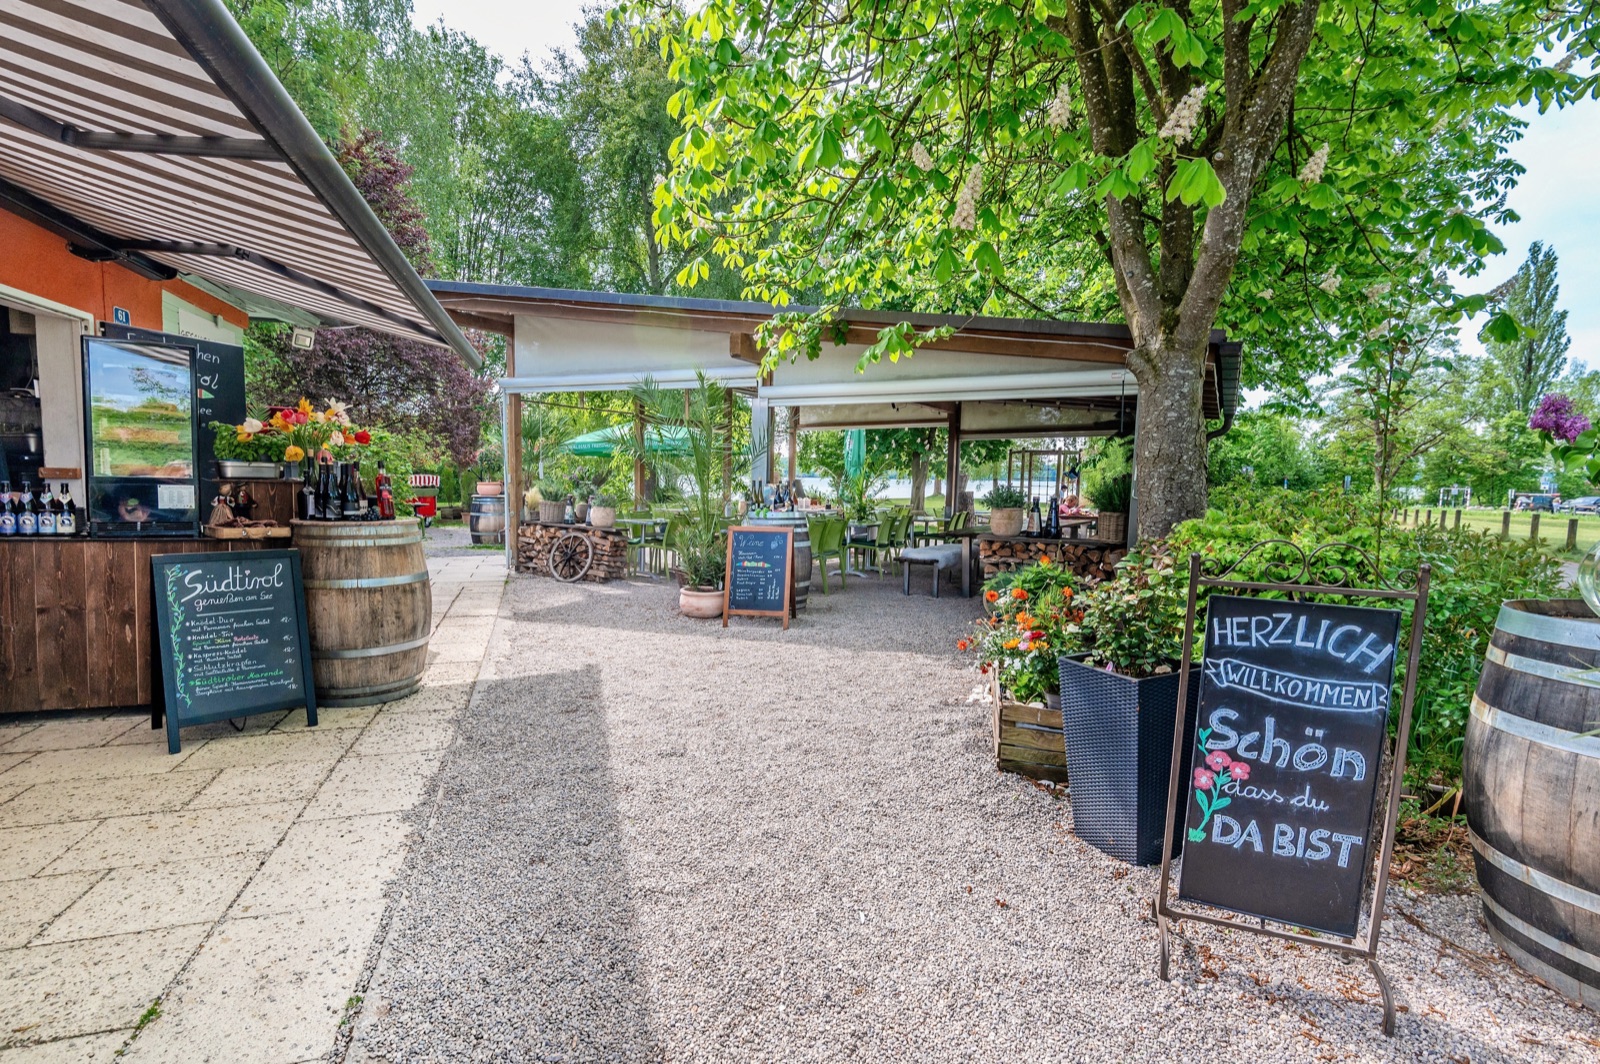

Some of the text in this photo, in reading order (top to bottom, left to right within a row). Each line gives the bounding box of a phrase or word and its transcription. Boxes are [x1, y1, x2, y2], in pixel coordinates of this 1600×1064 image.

[117, 309, 126, 322] 61
[181, 563, 284, 603] Südtirol
[260, 590, 273, 600] See
[1213, 613, 1393, 674] HERZLICH
[1226, 664, 1372, 708] WILLKOMMEN
[1205, 709, 1366, 781] Schön
[1222, 778, 1330, 811] dass du
[1211, 813, 1363, 868] DA BIST
